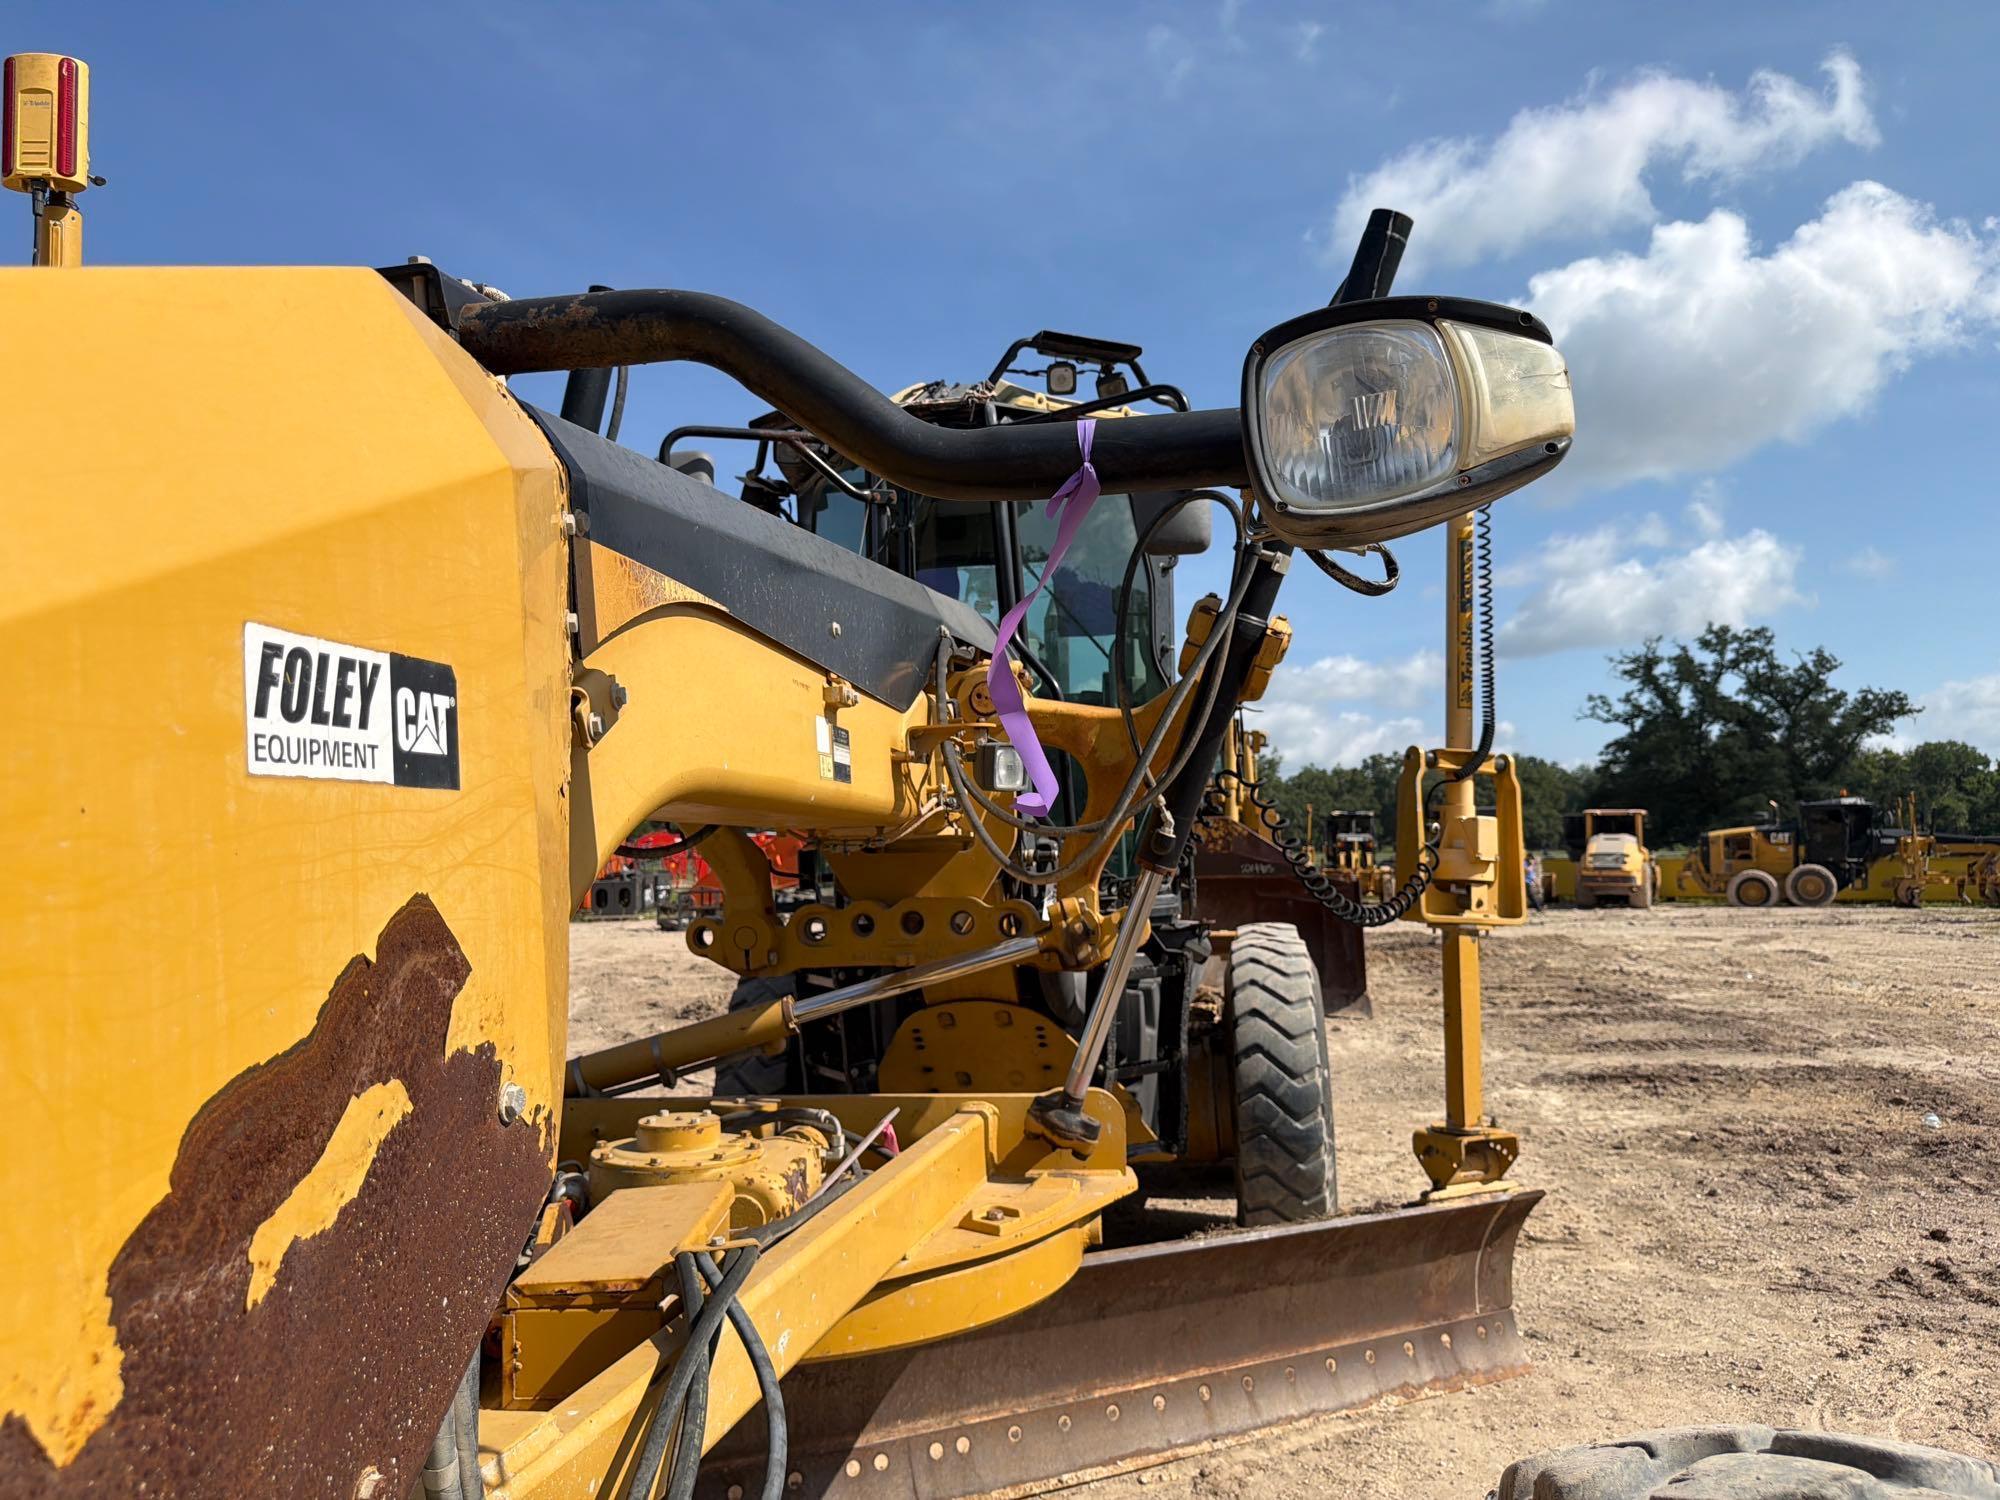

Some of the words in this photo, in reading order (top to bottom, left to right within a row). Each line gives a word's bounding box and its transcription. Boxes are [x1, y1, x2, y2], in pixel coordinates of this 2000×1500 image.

[254, 641, 382, 730] FOLEY
[254, 733, 379, 769] EQUIPMENT
[1770, 832, 1790, 844] CAT
